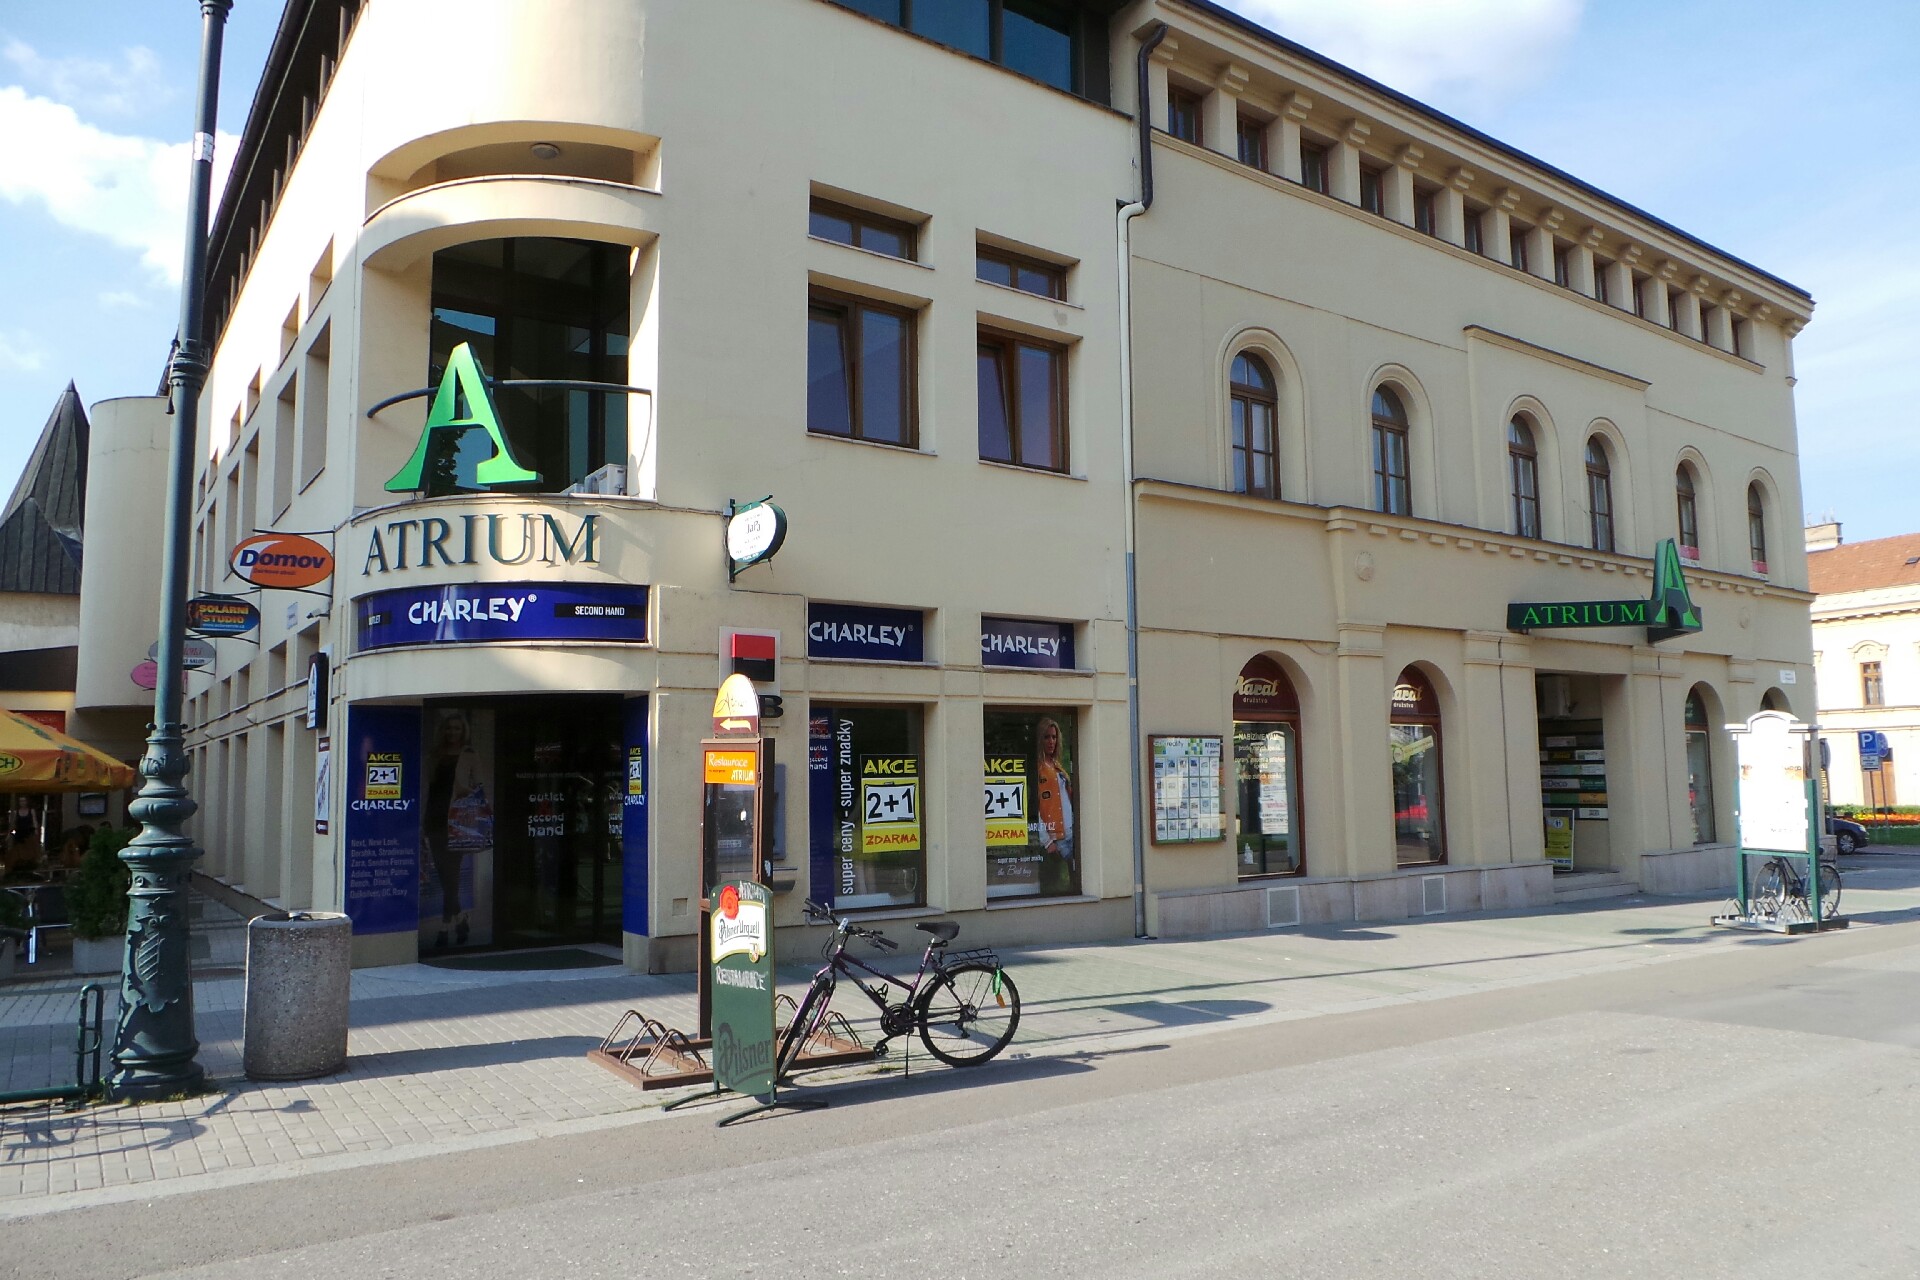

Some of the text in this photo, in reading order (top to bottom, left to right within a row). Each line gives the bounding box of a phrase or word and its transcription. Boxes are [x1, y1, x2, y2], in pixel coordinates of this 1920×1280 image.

[385, 341, 543, 493] A
[362, 513, 600, 576] ATRIUM
[239, 549, 326, 569] Domov
[575, 605, 625, 617] SECOND HAND
[1522, 604, 1646, 625] ATRIUM
[202, 615, 245, 625] STUDIO
[837, 719, 854, 766] značky
[1861, 733, 1873, 748] P
[368, 753, 401, 762] AKCE
[708, 753, 748, 767] Restaurace
[863, 759, 917, 774] AKCE
[369, 768, 399, 783] 2+1
[731, 769, 754, 781] ATRIUM
[840, 771, 854, 807] super
[528, 792, 565, 803] outlet
[867, 788, 914, 819] 2+1
[985, 786, 1022, 814] 2+1
[528, 813, 564, 824] second
[528, 824, 564, 837] hand
[840, 820, 855, 851] ceny
[986, 829, 1026, 840] DARMA
[865, 834, 918, 846] ZDARMA
[842, 856, 856, 895] super
